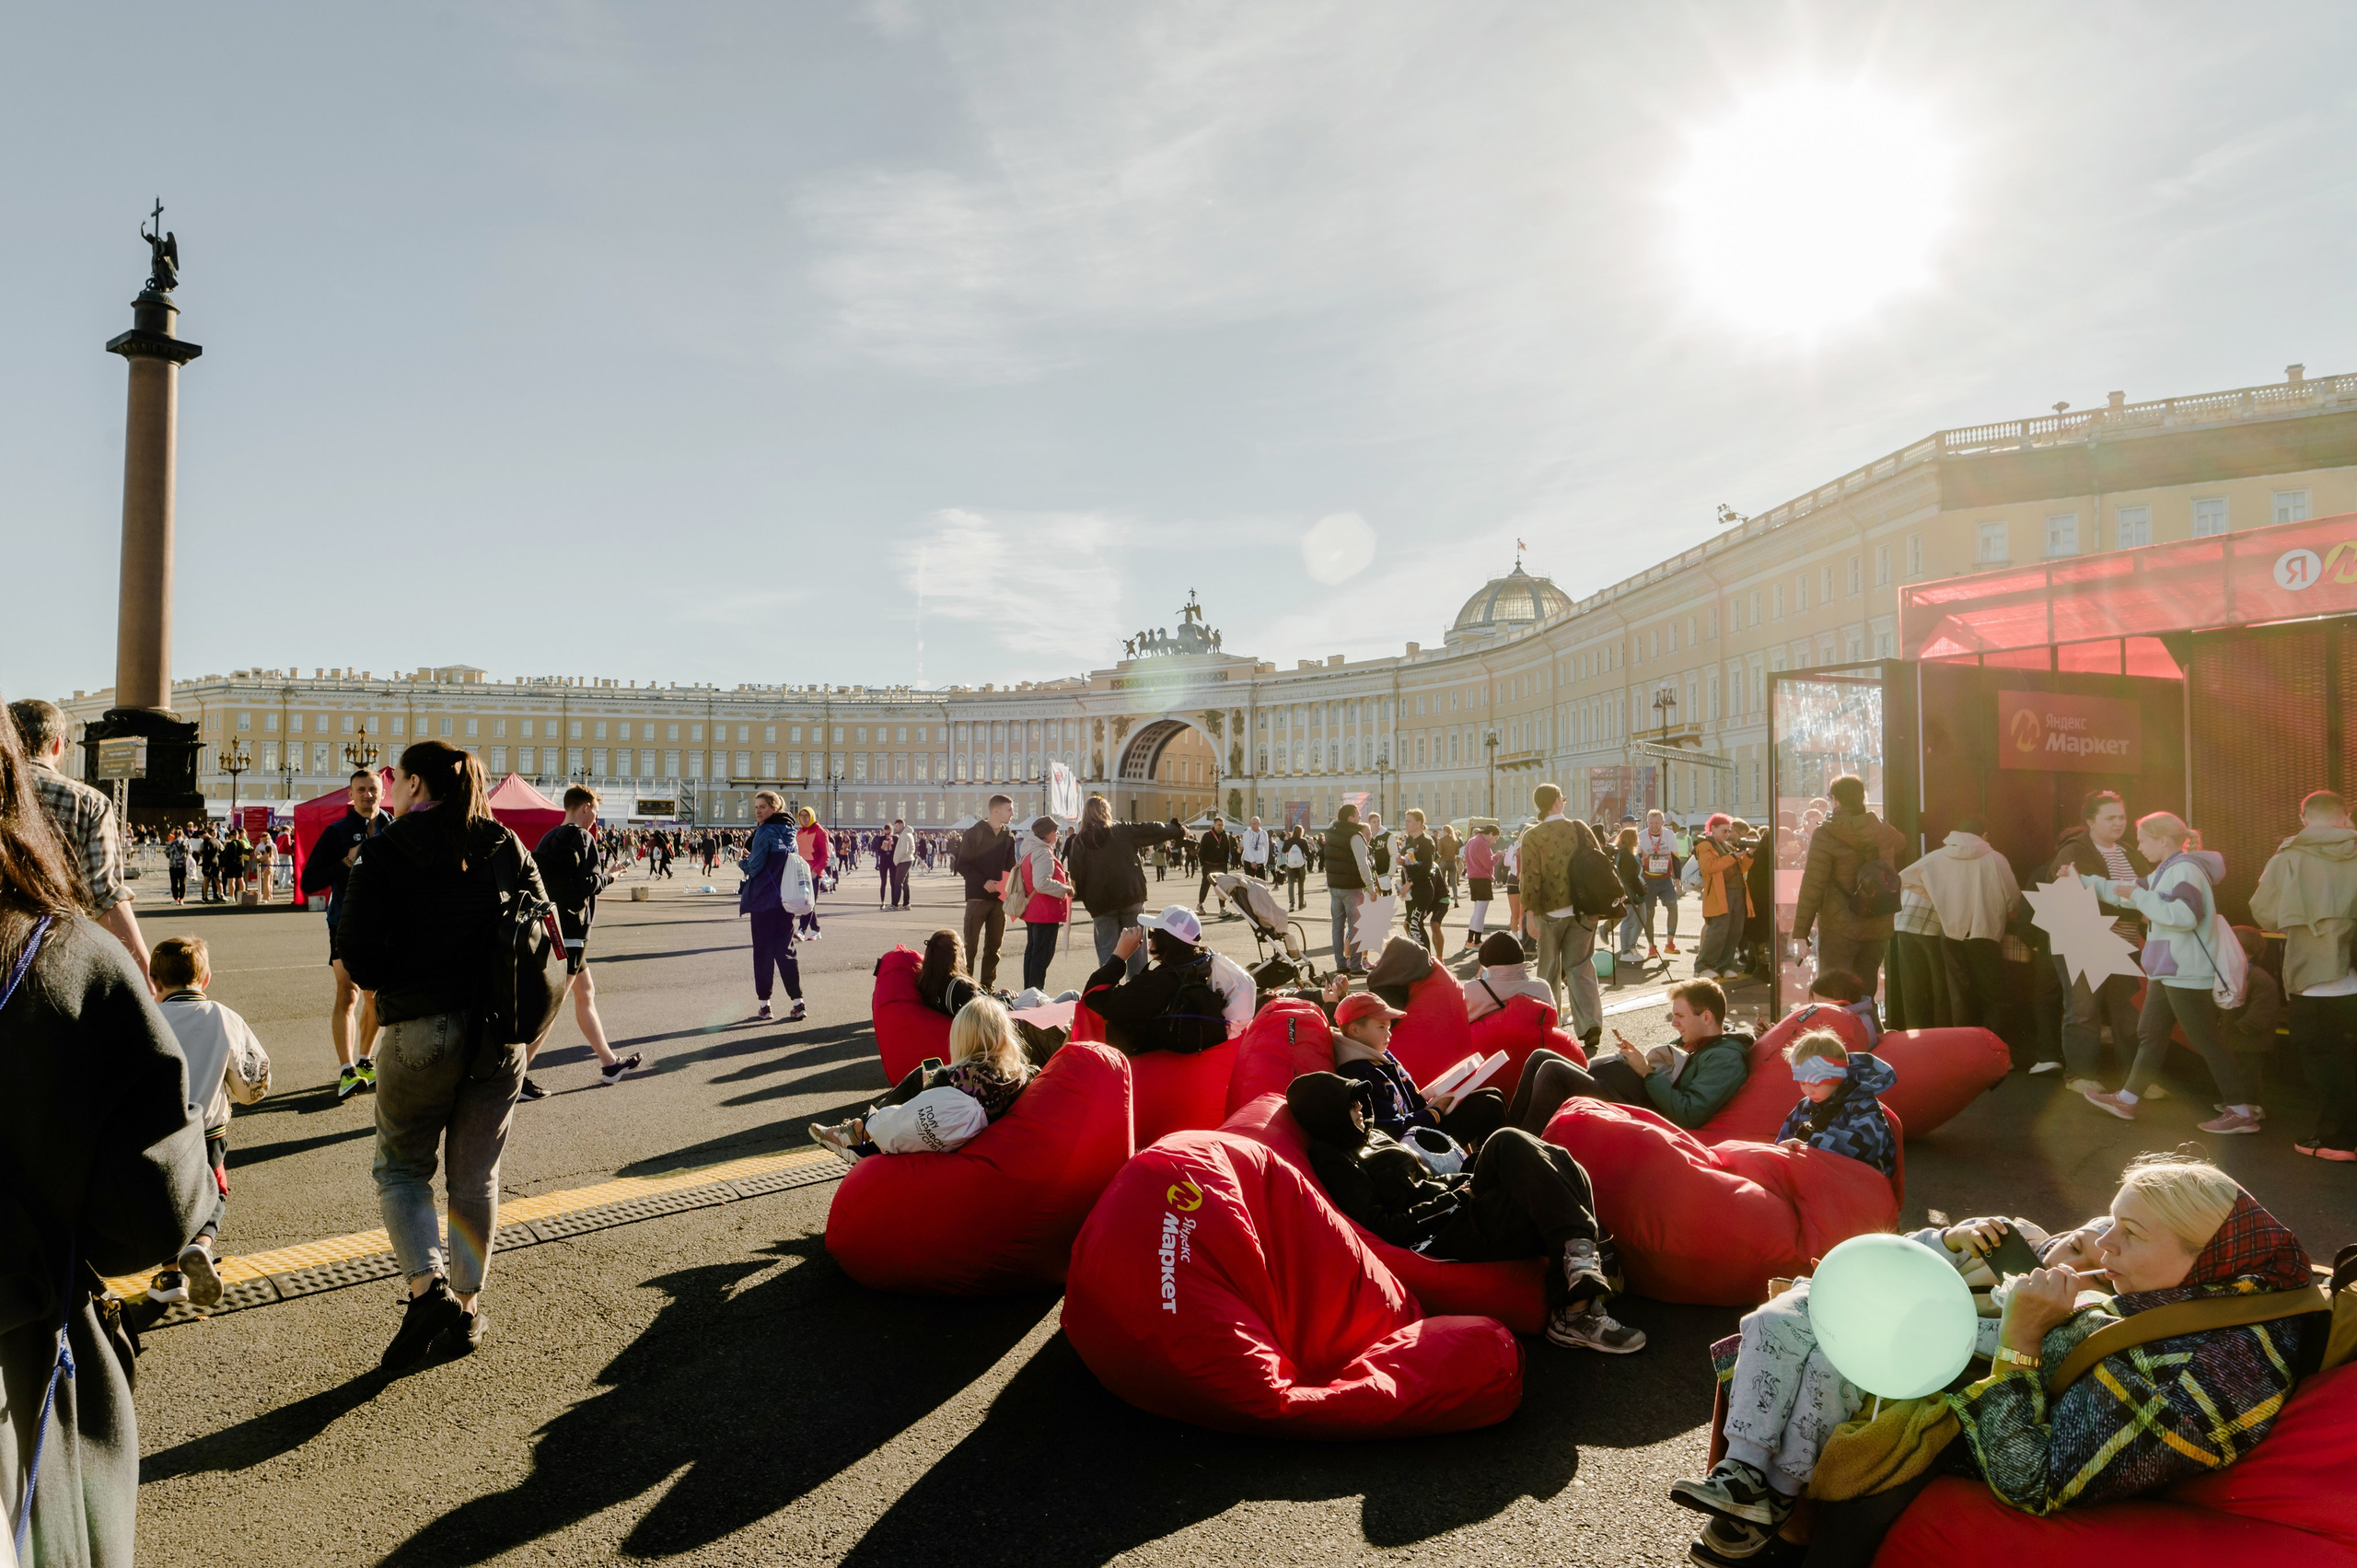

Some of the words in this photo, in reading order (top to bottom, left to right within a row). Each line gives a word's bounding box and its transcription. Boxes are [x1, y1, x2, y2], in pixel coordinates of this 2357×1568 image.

[2285, 555, 2308, 585] Я
[2045, 713, 2087, 731] Яндекс
[2045, 732, 2131, 757] Маркет
[917, 1108, 947, 1149] МАРАФОН
[925, 1105, 939, 1129] ПОЛУ
[1158, 1211, 1180, 1315] Маркет
